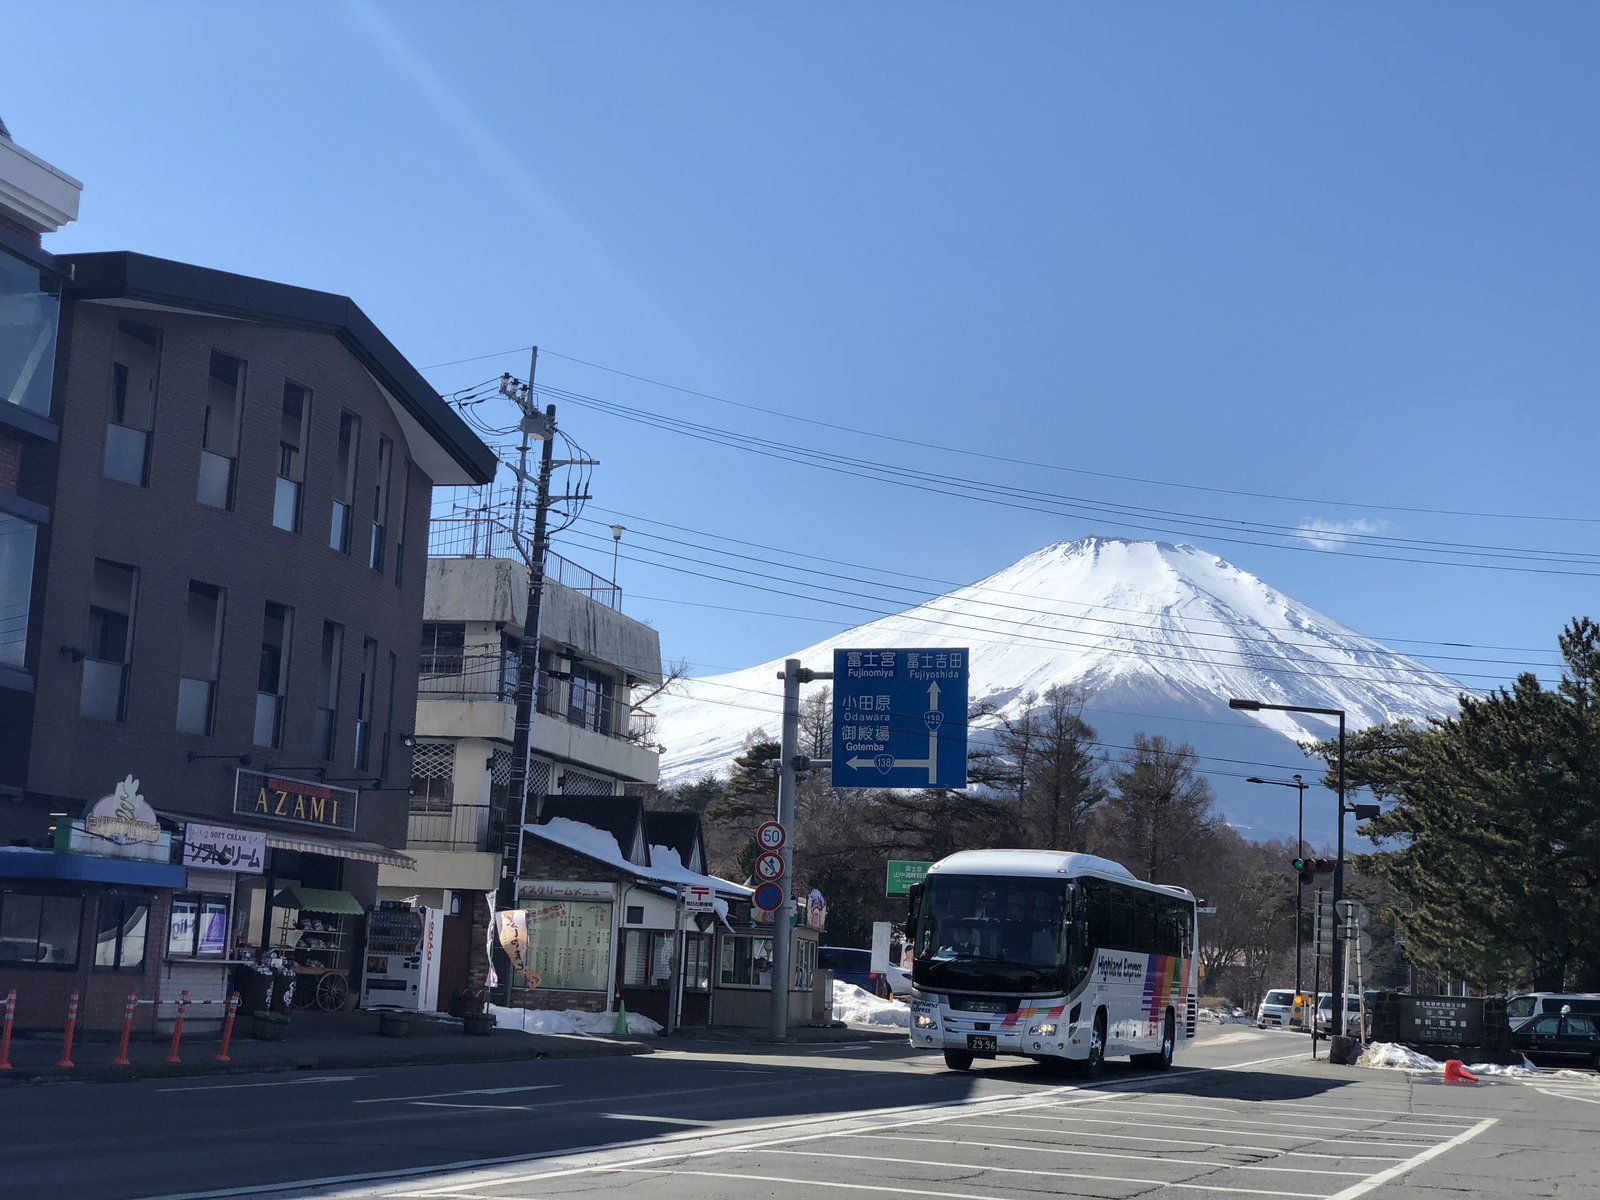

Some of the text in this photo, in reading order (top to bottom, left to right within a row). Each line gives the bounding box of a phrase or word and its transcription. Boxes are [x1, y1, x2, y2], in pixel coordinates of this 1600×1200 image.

[847, 651, 896, 667] 富士宮
[907, 653, 962, 668] 富士吉田
[848, 668, 894, 678] Fujinomiya
[910, 670, 959, 680] Fujiyoshida
[842, 695, 891, 711] 小田原
[843, 712, 890, 721] Odawara
[927, 715, 941, 724] 138
[841, 725, 890, 741] 御殿場
[845, 742, 885, 751] Gotemba
[877, 758, 891, 768] 138
[254, 787, 338, 824] AZAMI
[210, 831, 247, 842] SOFT CREAM
[763, 829, 780, 843] 50
[1097, 955, 1142, 983] Highland Express
[911, 999, 938, 1009] Highland
[911, 1006, 931, 1014] Express
[972, 1039, 996, 1050] 29-96
